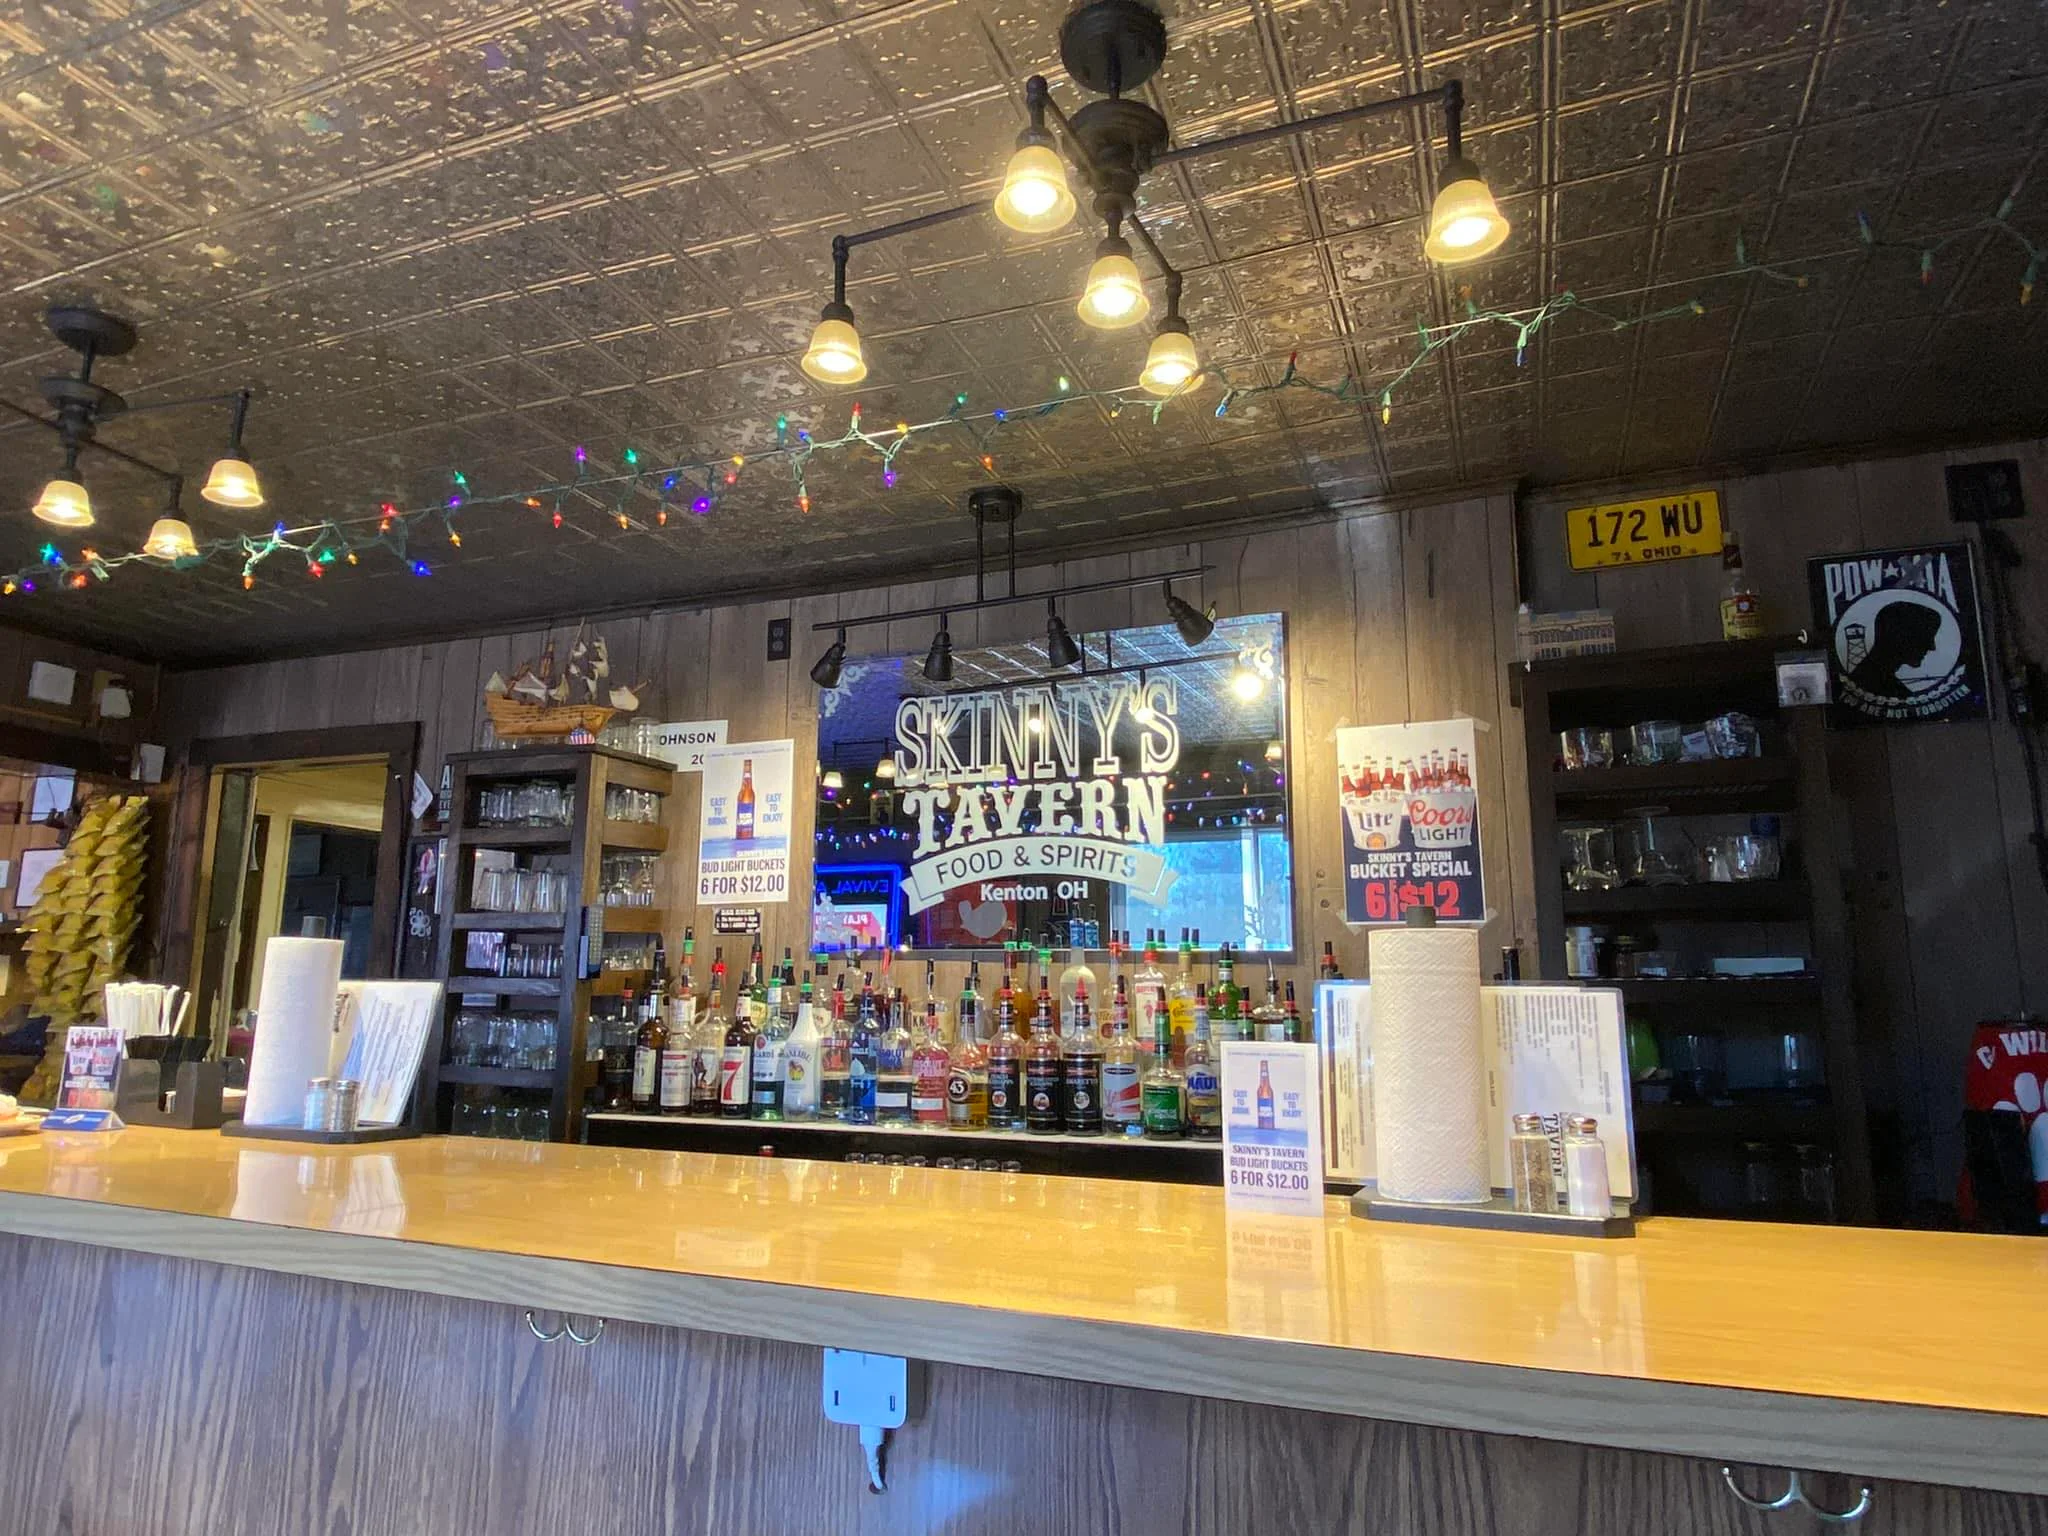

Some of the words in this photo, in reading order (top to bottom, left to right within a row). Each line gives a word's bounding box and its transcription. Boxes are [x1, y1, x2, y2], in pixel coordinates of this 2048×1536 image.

[1587, 509, 1649, 548] 172
[1660, 501, 1703, 538] WU
[1642, 545, 1682, 559] OHIO
[1823, 558, 1883, 626] POW
[1886, 707, 1909, 719] NOT
[1915, 684, 1973, 717] FORGOTTEN
[659, 732, 716, 746] OHNSON
[894, 676, 1181, 788] SKINNY'S
[902, 775, 1169, 859] TAVERN
[1409, 799, 1472, 827] Coors
[1419, 827, 1467, 841] LIGHT
[701, 861, 719, 874] BUD
[720, 859, 746, 873] LIGHT
[746, 858, 786, 872] BUCKETS
[935, 849, 1004, 886] FOOD
[1013, 845, 1032, 868] &
[1040, 844, 1138, 879] SPIRITS
[1367, 851, 1412, 864] SKINNY'S
[1414, 850, 1452, 862] TAVERN
[1350, 862, 1408, 880] BUCKET
[1412, 860, 1473, 878] SPECIAL
[700, 877, 710, 896] 6
[712, 876, 738, 895] FOR
[740, 874, 785, 895] $12.00
[980, 882, 1049, 903] Kenton
[1056, 880, 1089, 899] OH
[1365, 881, 1387, 919] 6
[721, 1061, 745, 1101] 7
[949, 1080, 965, 1095] 43
[1232, 1144, 1271, 1157] SKINNY'S
[1271, 1147, 1305, 1159] TAVERN
[1230, 1156, 1247, 1167] BUD
[1247, 1157, 1269, 1169] LIGHT
[1271, 1159, 1309, 1172] BUCKETS
[1230, 1169, 1239, 1185] 6
[1240, 1170, 1264, 1187] FOR
[1266, 1171, 1310, 1191] $12.00
